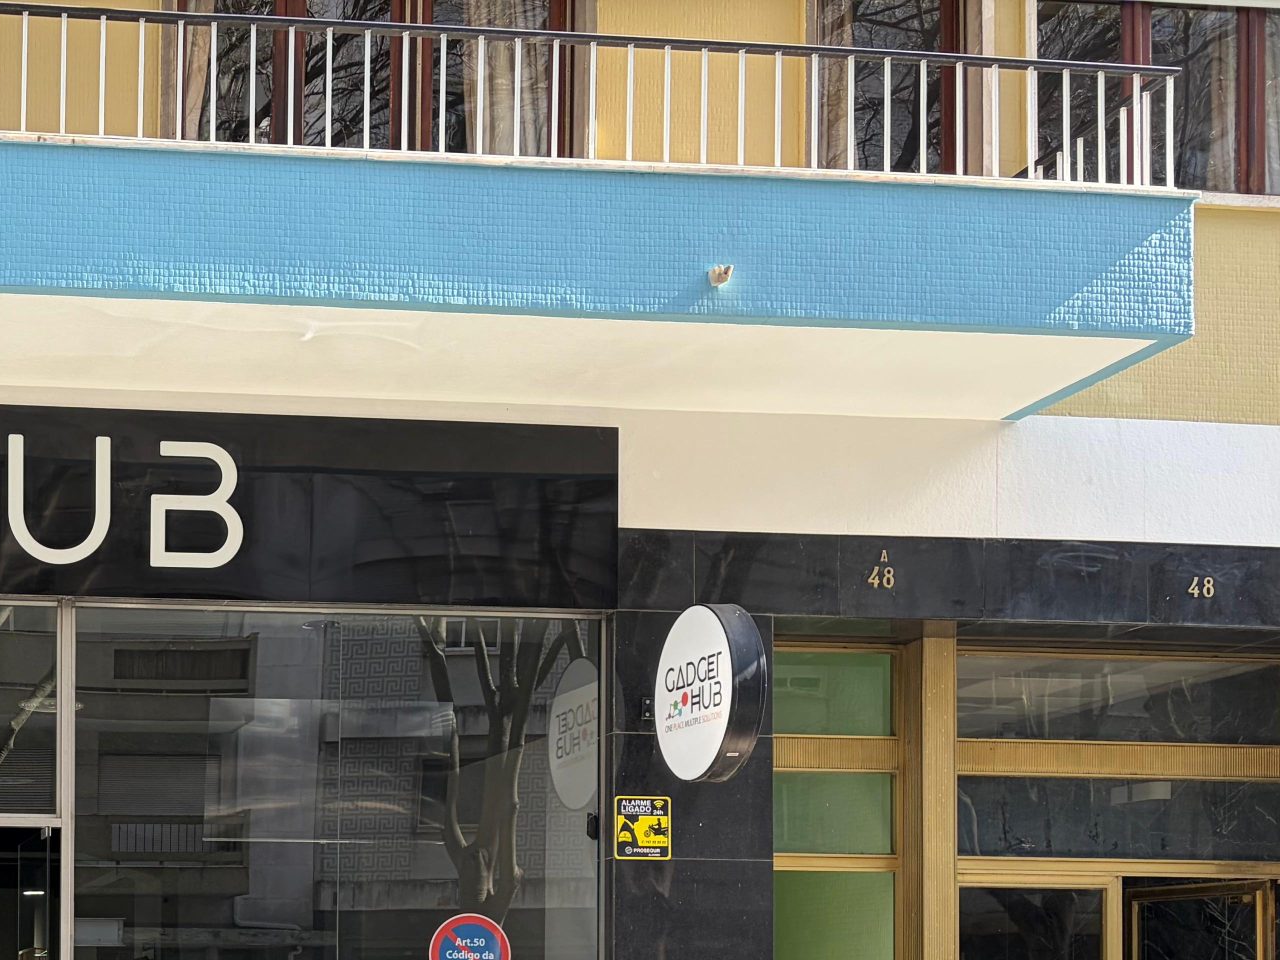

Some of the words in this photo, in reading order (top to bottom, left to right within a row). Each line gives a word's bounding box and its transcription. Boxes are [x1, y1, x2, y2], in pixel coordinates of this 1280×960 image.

[880, 549, 888, 562] A
[867, 566, 895, 589] 48
[1187, 576, 1215, 598] 48
[665, 651, 722, 692] GADGET
[691, 680, 723, 714] HUB
[621, 805, 651, 813] LIGADO
[455, 937, 486, 947] Art.50
[482, 951, 495, 960] da
